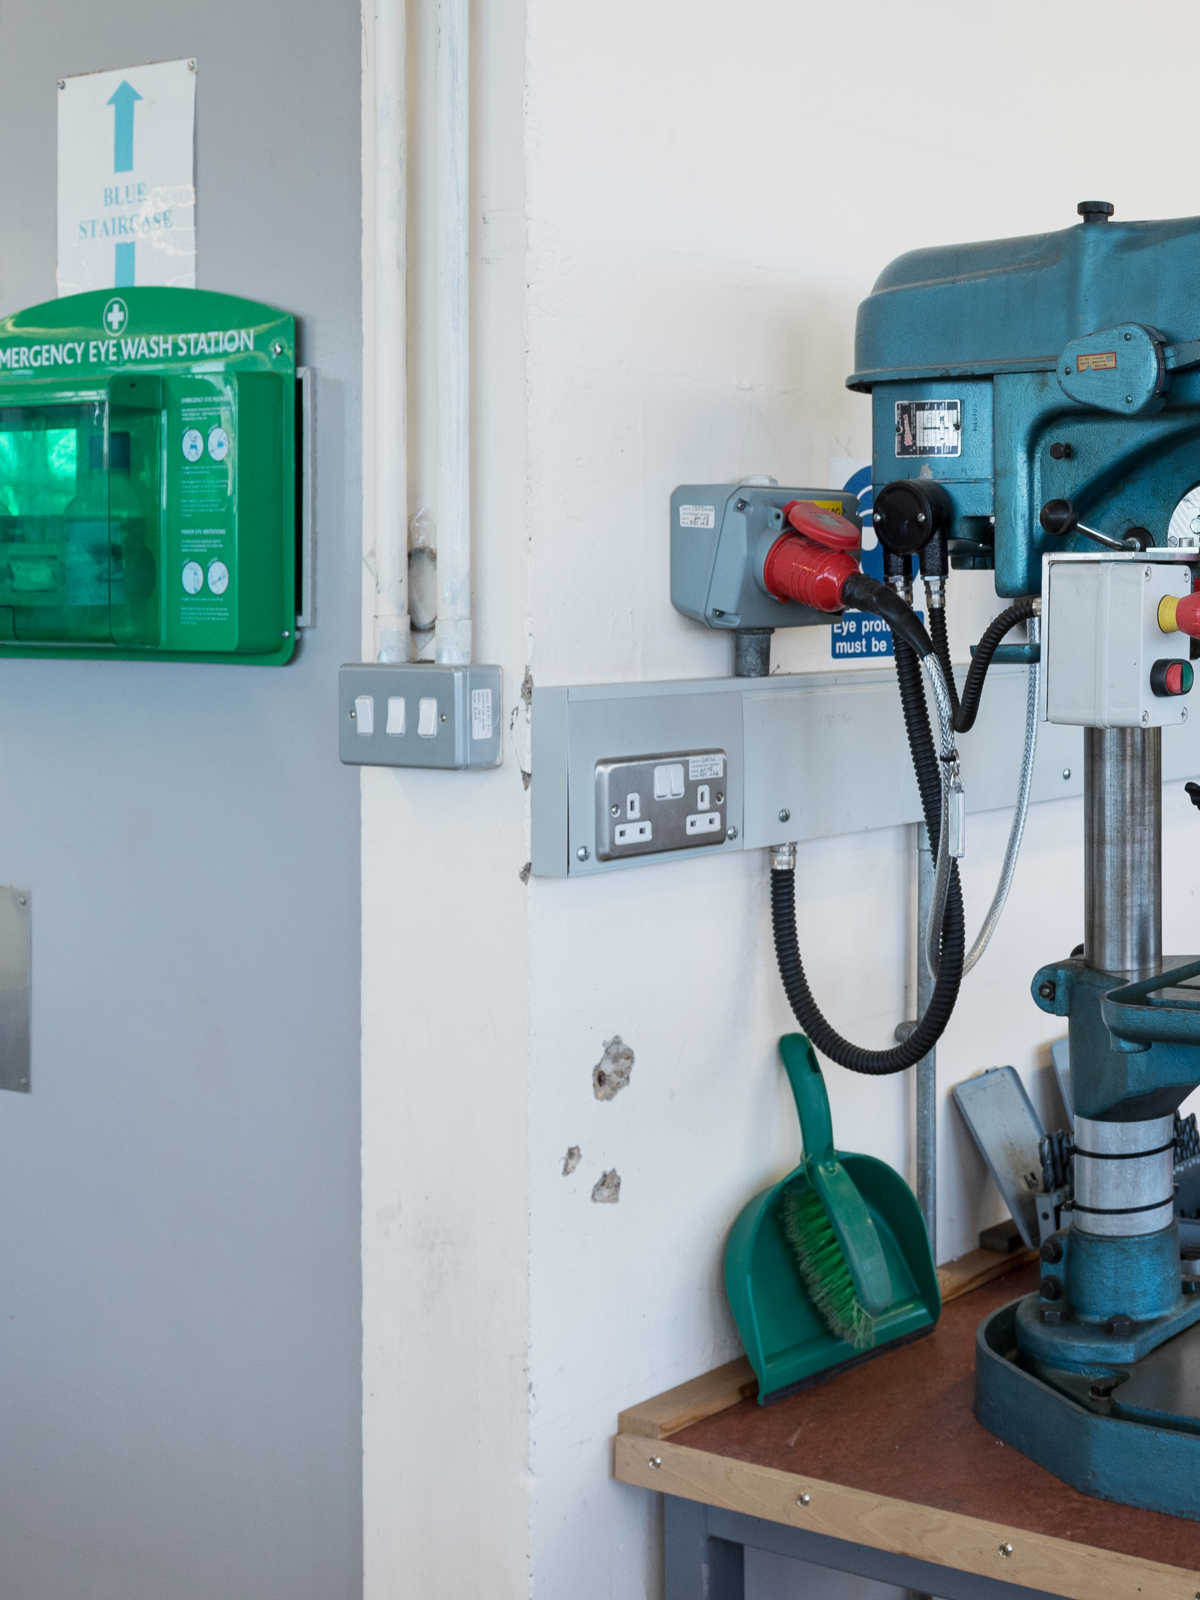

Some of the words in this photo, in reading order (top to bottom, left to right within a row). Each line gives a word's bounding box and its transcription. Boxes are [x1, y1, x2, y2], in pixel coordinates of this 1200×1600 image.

[103, 183, 146, 207] BLUE
[79, 208, 174, 239] STAIRCASE
[0, 342, 85, 369] MERGENCY
[88, 340, 118, 363] EYE
[120, 335, 172, 361] WASH
[177, 329, 255, 356] STATION
[833, 620, 857, 636] Eye
[835, 638, 867, 654] must
[871, 636, 888, 653] be
